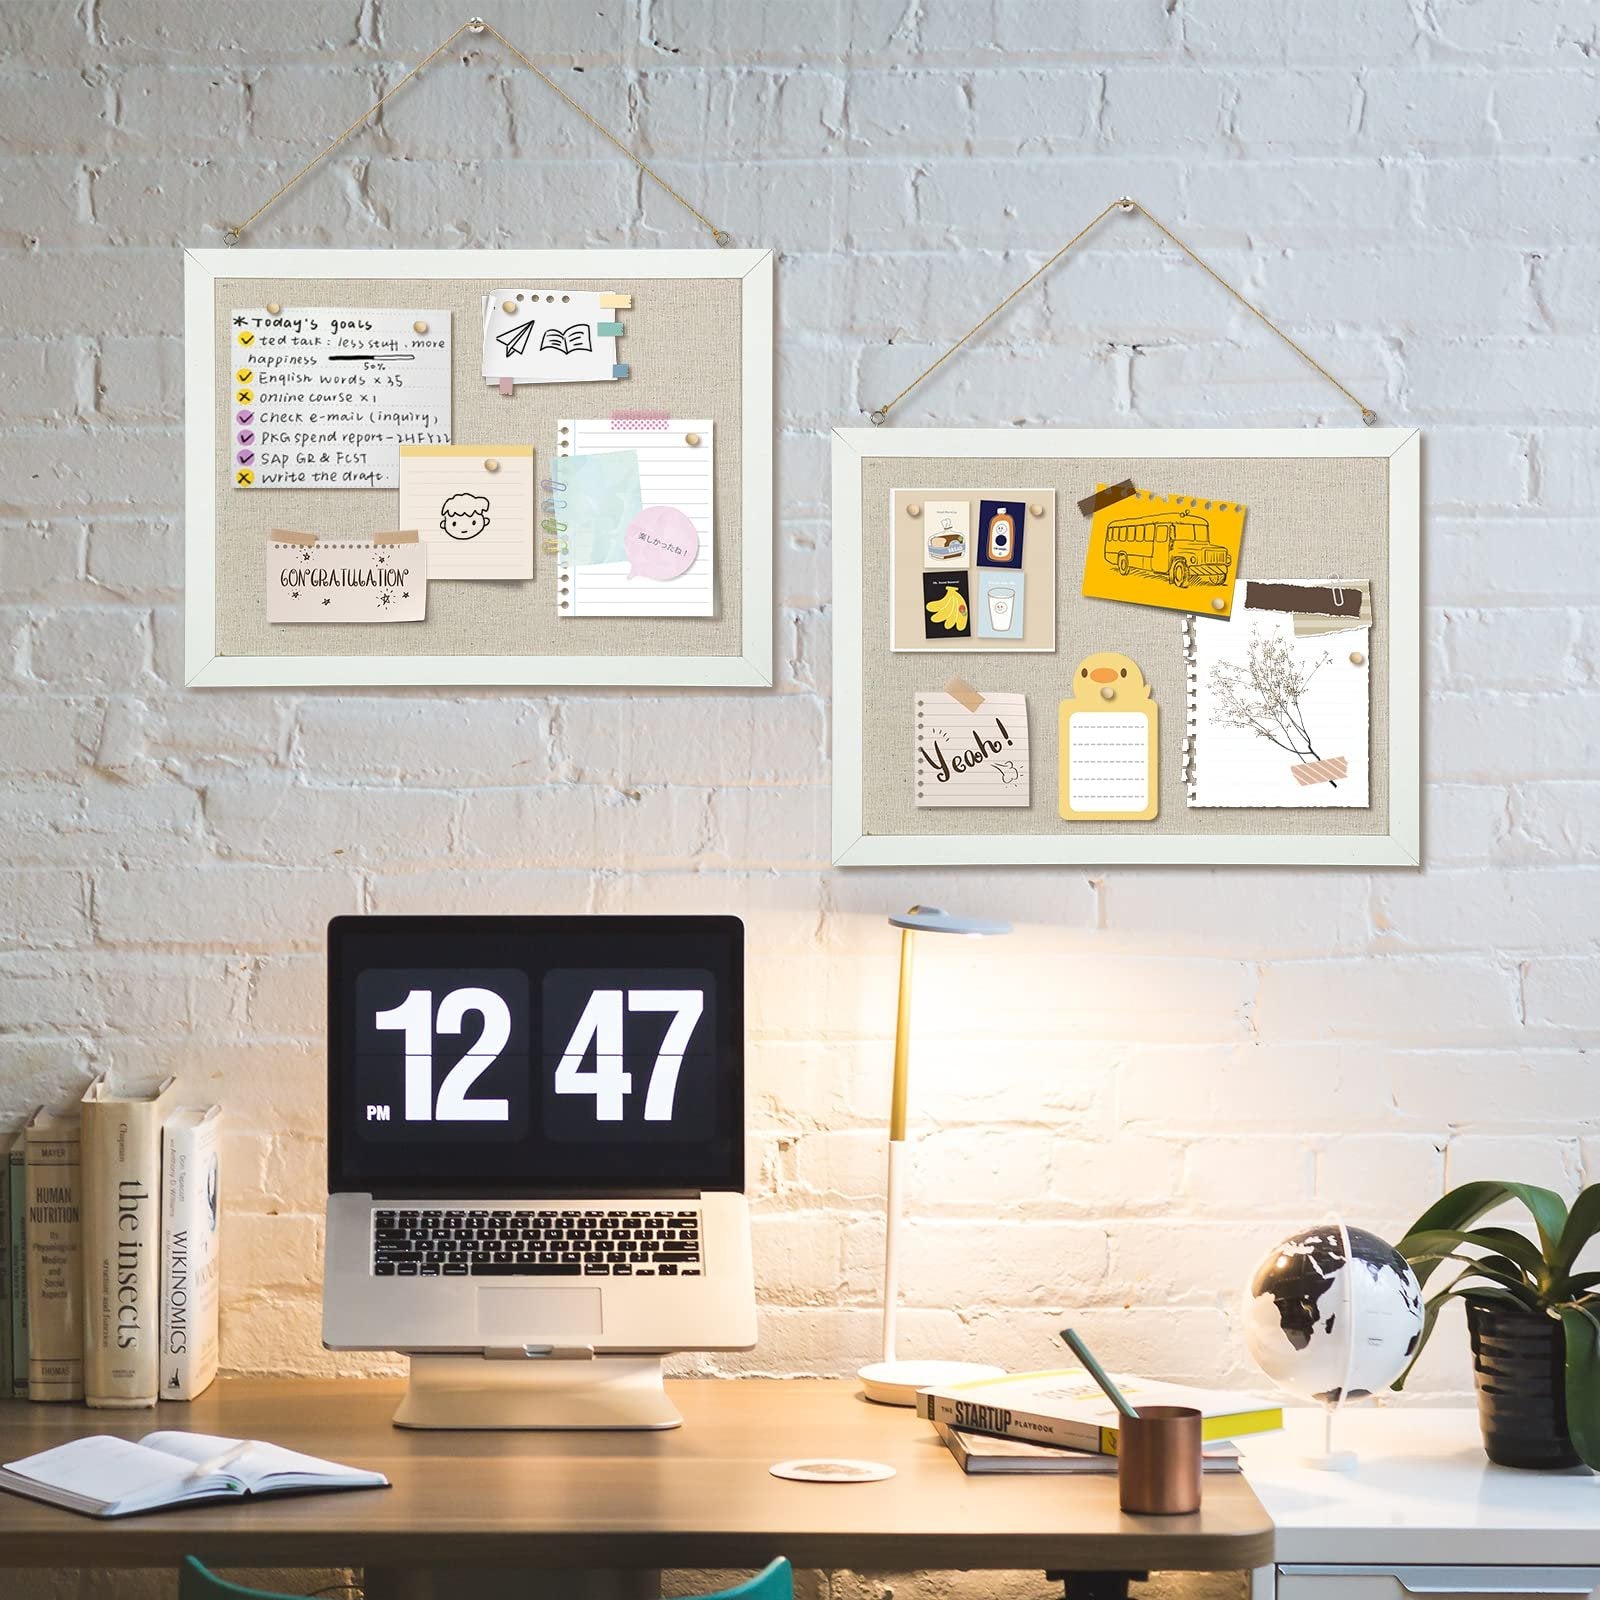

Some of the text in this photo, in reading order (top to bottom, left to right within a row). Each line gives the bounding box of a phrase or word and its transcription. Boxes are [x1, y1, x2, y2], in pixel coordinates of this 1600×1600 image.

[252, 317, 373, 335] Today's goals
[259, 336, 287, 347] ted
[338, 337, 365, 350] less
[412, 339, 446, 349] more
[248, 353, 318, 366] happiness
[363, 362, 387, 371] 50%
[259, 373, 312, 386] English
[320, 374, 367, 386] words
[309, 393, 353, 403] course
[309, 410, 364, 423] e-mail
[261, 432, 291, 444] PKG
[294, 431, 337, 447] spend
[296, 453, 317, 464] GR
[320, 453, 330, 464] &
[336, 452, 367, 464] FCST
[311, 471, 337, 482] the
[919, 717, 1014, 783] Yeah!
[375, 987, 704, 1121] 12 47
[366, 1104, 391, 1121] PM
[36, 1186, 72, 1204] HUMAN
[118, 1179, 149, 1231] the
[29, 1206, 80, 1224] NUTRITION
[117, 1242, 143, 1350] insects
[170, 1230, 187, 1354] WIKINOMICS
[41, 1366, 71, 1377] THOMAS
[941, 1406, 953, 1414] THE
[955, 1400, 1012, 1433] STARTUP
[1014, 1419, 1054, 1433] PLAYBOOK
